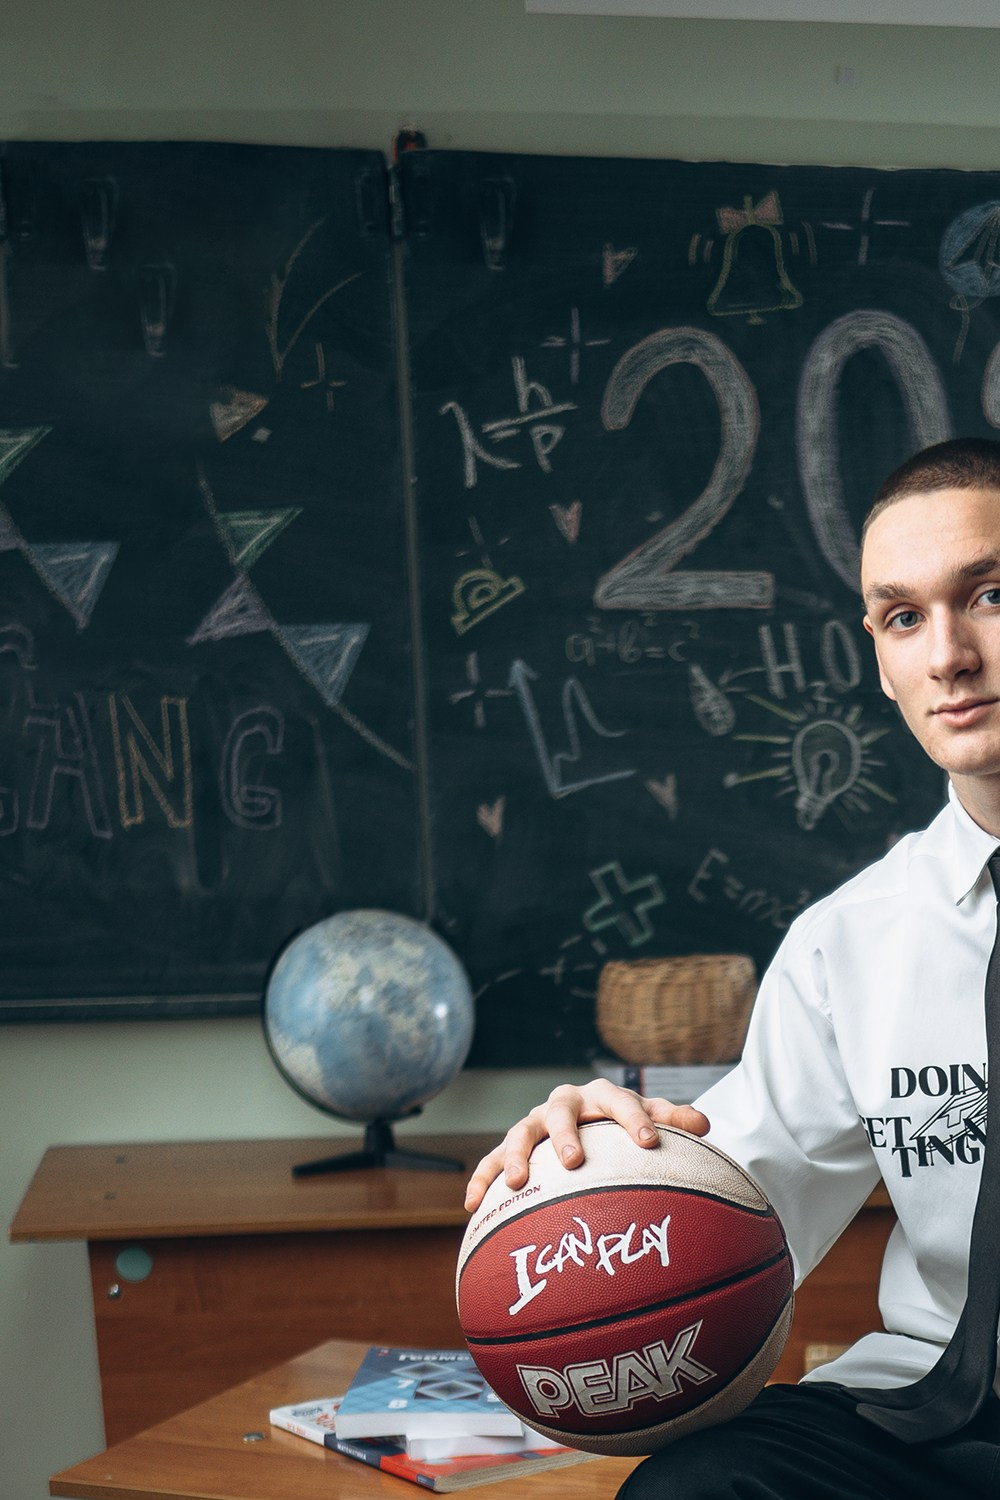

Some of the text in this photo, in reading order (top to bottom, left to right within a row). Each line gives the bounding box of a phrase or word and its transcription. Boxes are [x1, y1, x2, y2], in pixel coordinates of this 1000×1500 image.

[890, 1063, 988, 1098] DOIN
[859, 1115, 912, 1148] ET
[498, 1184, 541, 1212] EDITION
[508, 1214, 671, 1316] I CAN PLAY
[515, 1318, 718, 1419] PEAK
